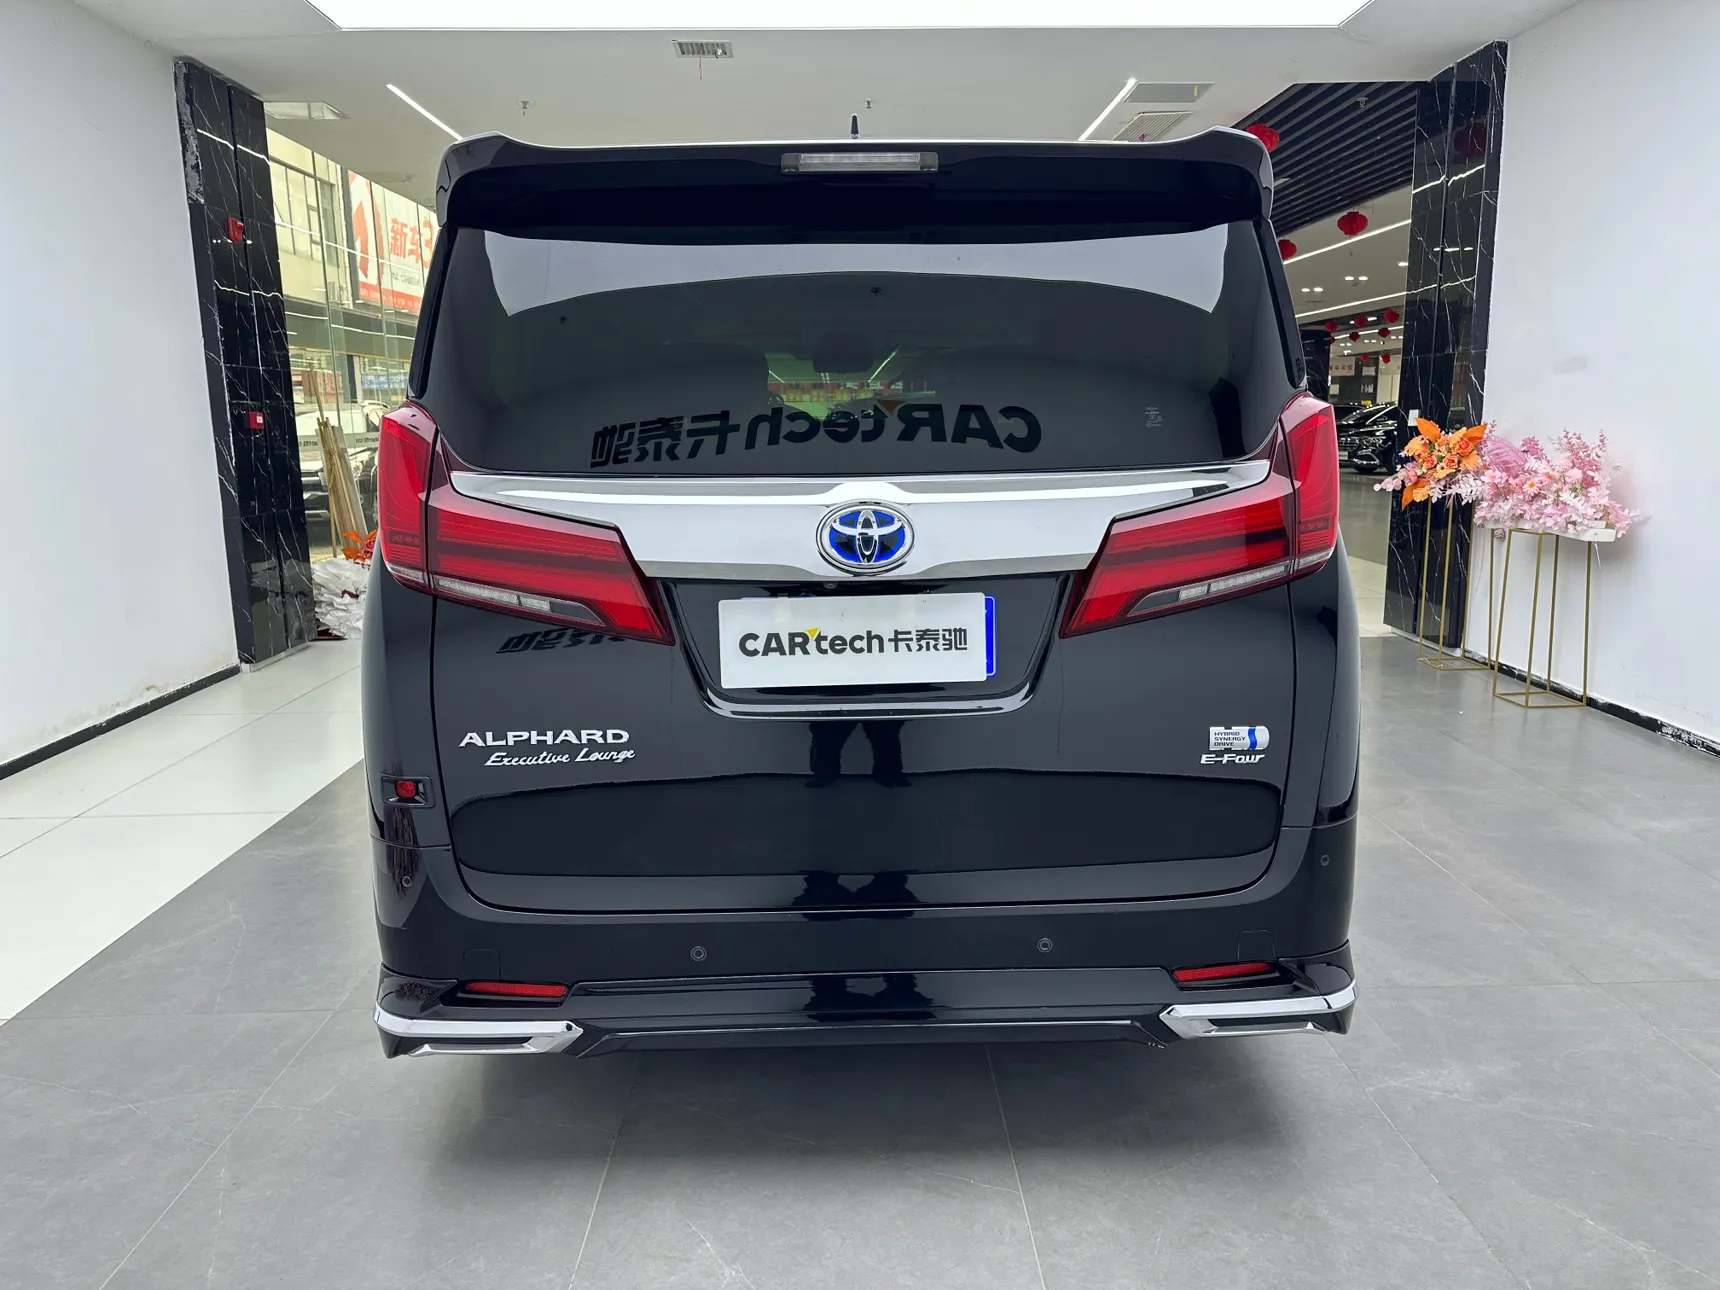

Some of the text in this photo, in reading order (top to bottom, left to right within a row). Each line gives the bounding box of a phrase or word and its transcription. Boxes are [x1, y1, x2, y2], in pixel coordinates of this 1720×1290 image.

[458, 729, 630, 748] ALPHARD
[484, 747, 636, 766] Executive Lounge
[1200, 753, 1266, 765] E-Four
